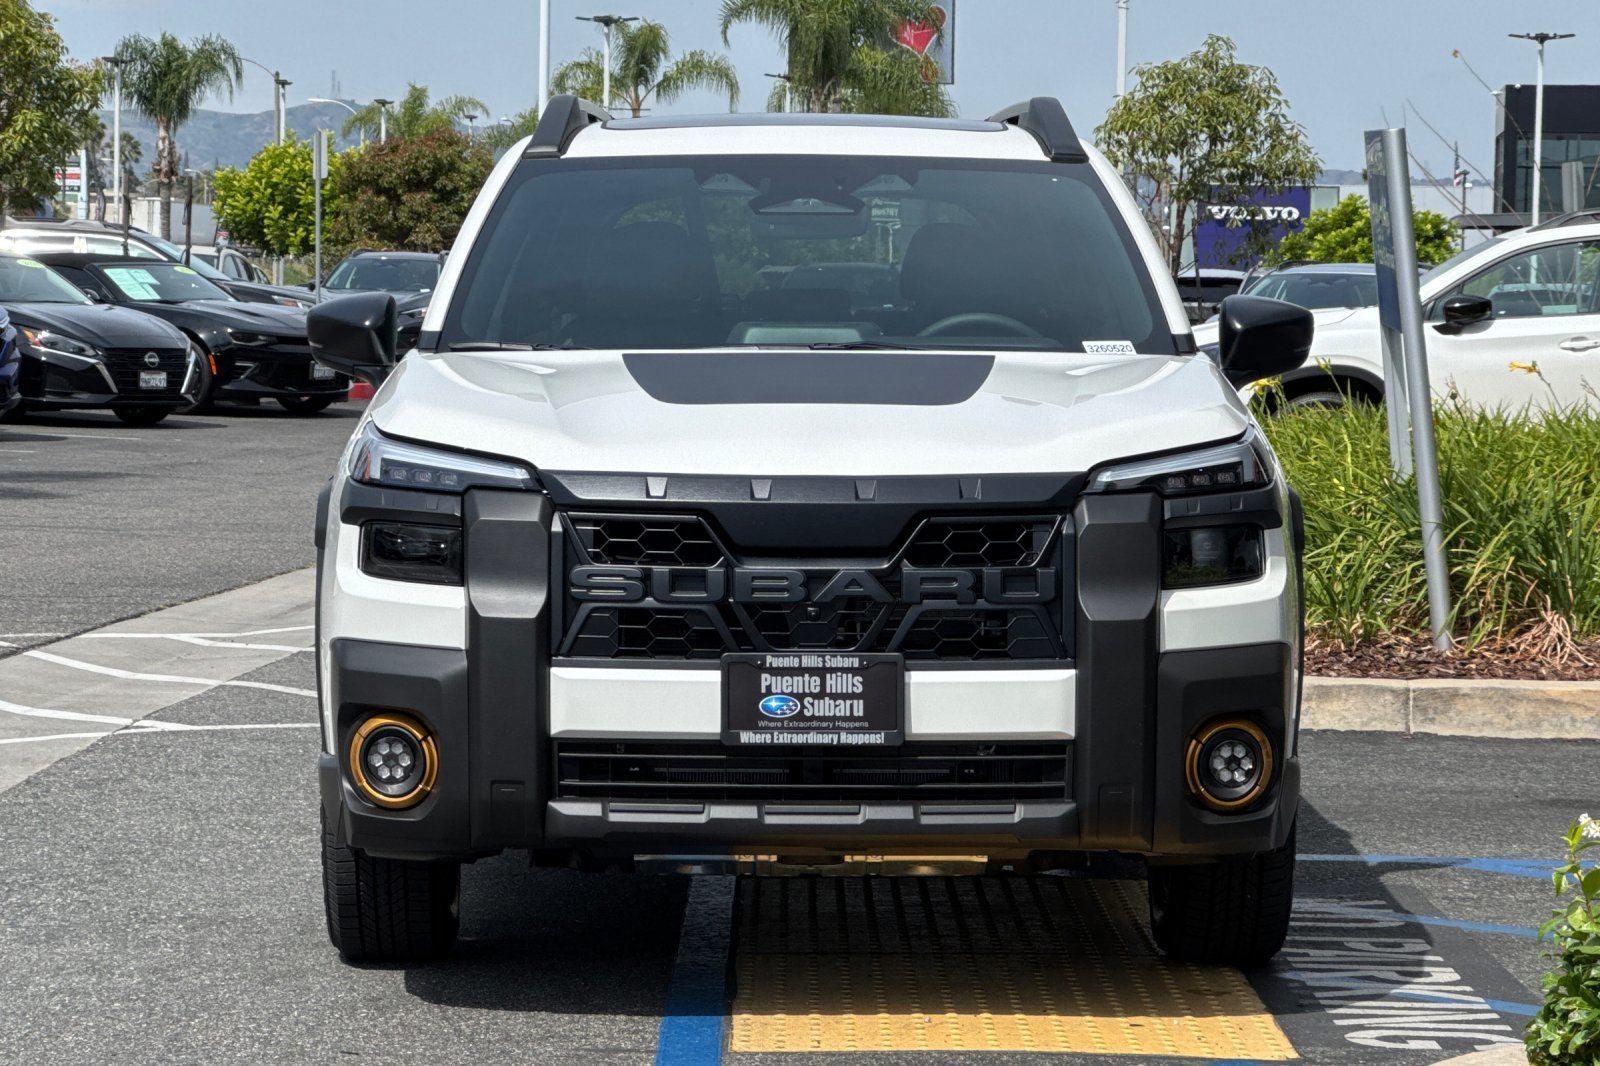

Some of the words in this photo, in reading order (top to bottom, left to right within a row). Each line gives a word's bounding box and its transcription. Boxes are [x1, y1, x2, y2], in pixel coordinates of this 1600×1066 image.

[1086, 344, 1133, 353] 3260520
[568, 565, 1058, 605] SUBARU
[766, 655, 799, 668] Puente
[801, 655, 823, 668] Hills
[825, 655, 859, 668] Subaru
[760, 673, 821, 694] Puente
[825, 672, 864, 694] Hills
[803, 696, 864, 717] Subaru
[758, 720, 782, 728] Where
[784, 720, 833, 729] Extraordinary
[835, 720, 869, 729] Happens
[740, 731, 772, 744] Where
[773, 731, 839, 745] Extraordinary
[840, 731, 885, 745] Happens!
[1281, 937, 1527, 1051] PARKING
